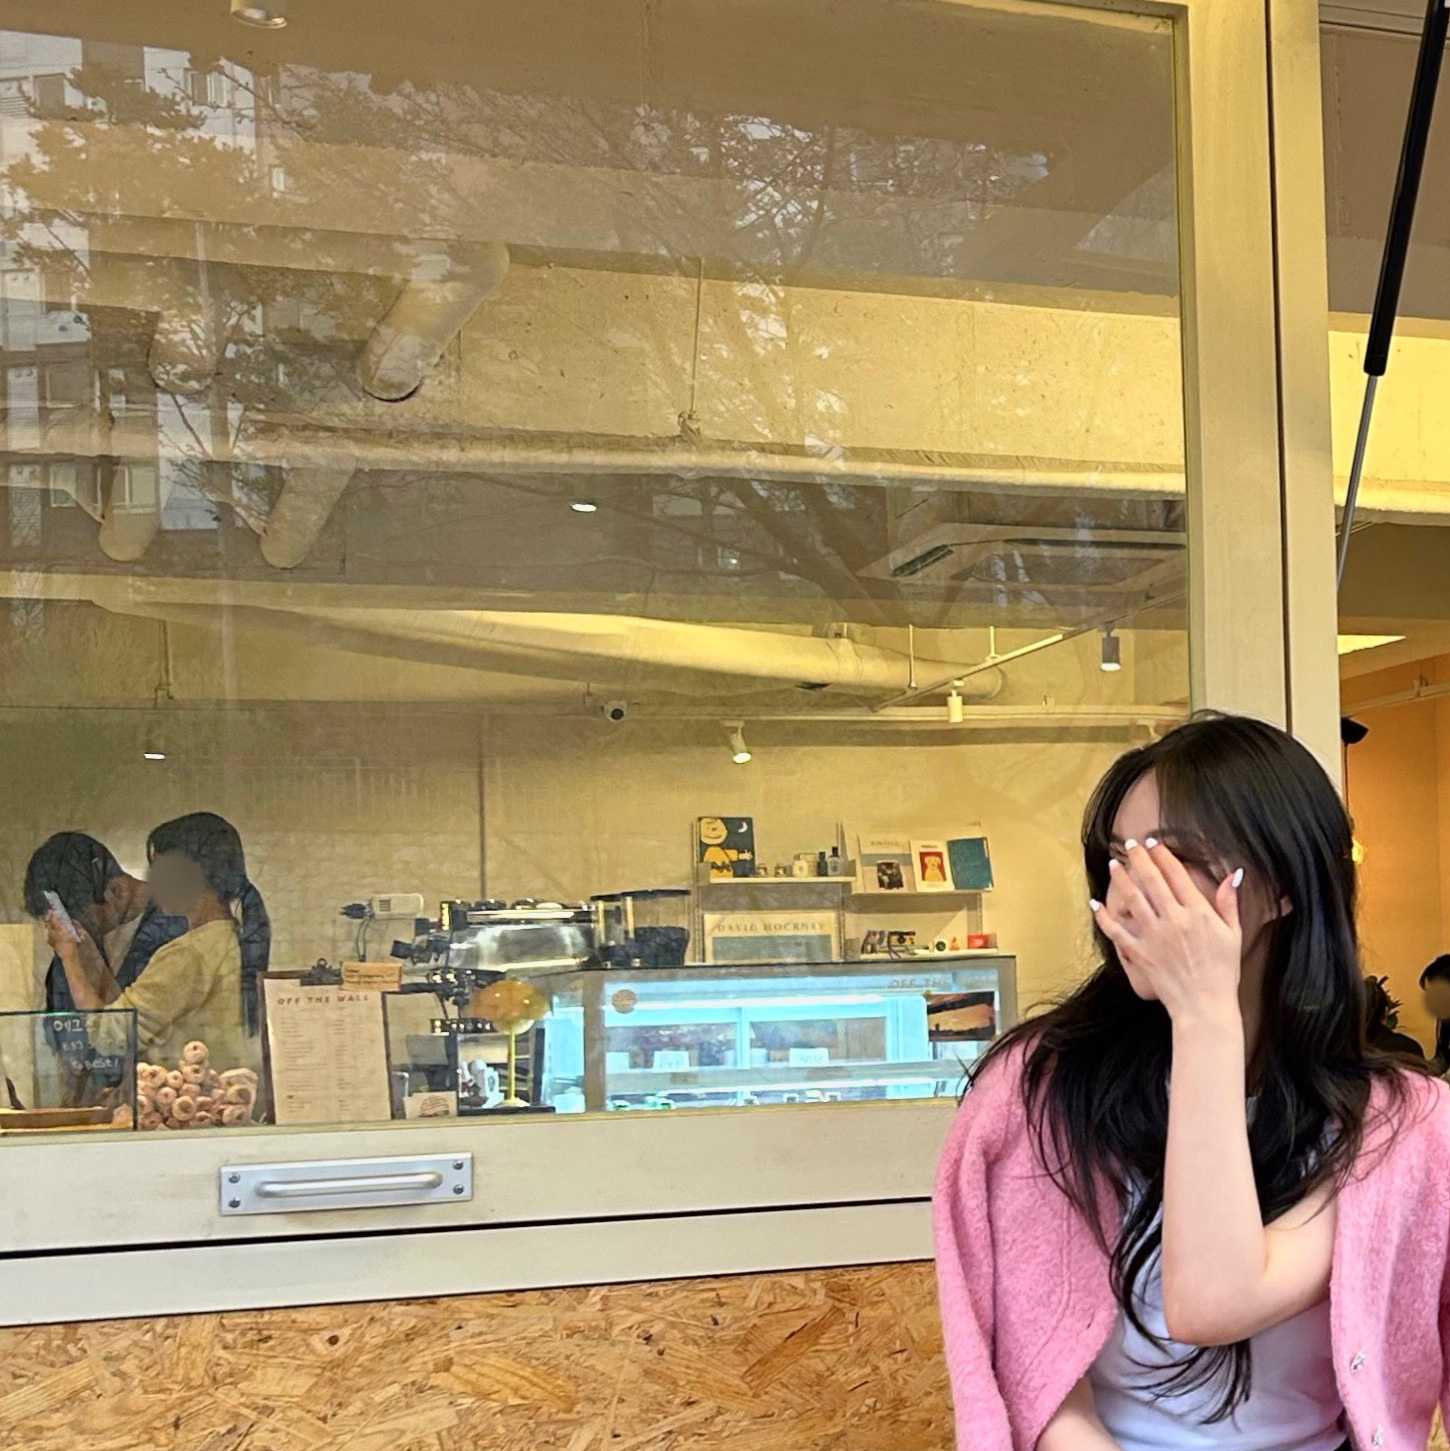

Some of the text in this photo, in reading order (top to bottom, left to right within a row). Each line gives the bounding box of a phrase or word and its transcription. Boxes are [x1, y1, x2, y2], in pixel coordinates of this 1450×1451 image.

[277, 994, 369, 1005] OFF THE WALL
